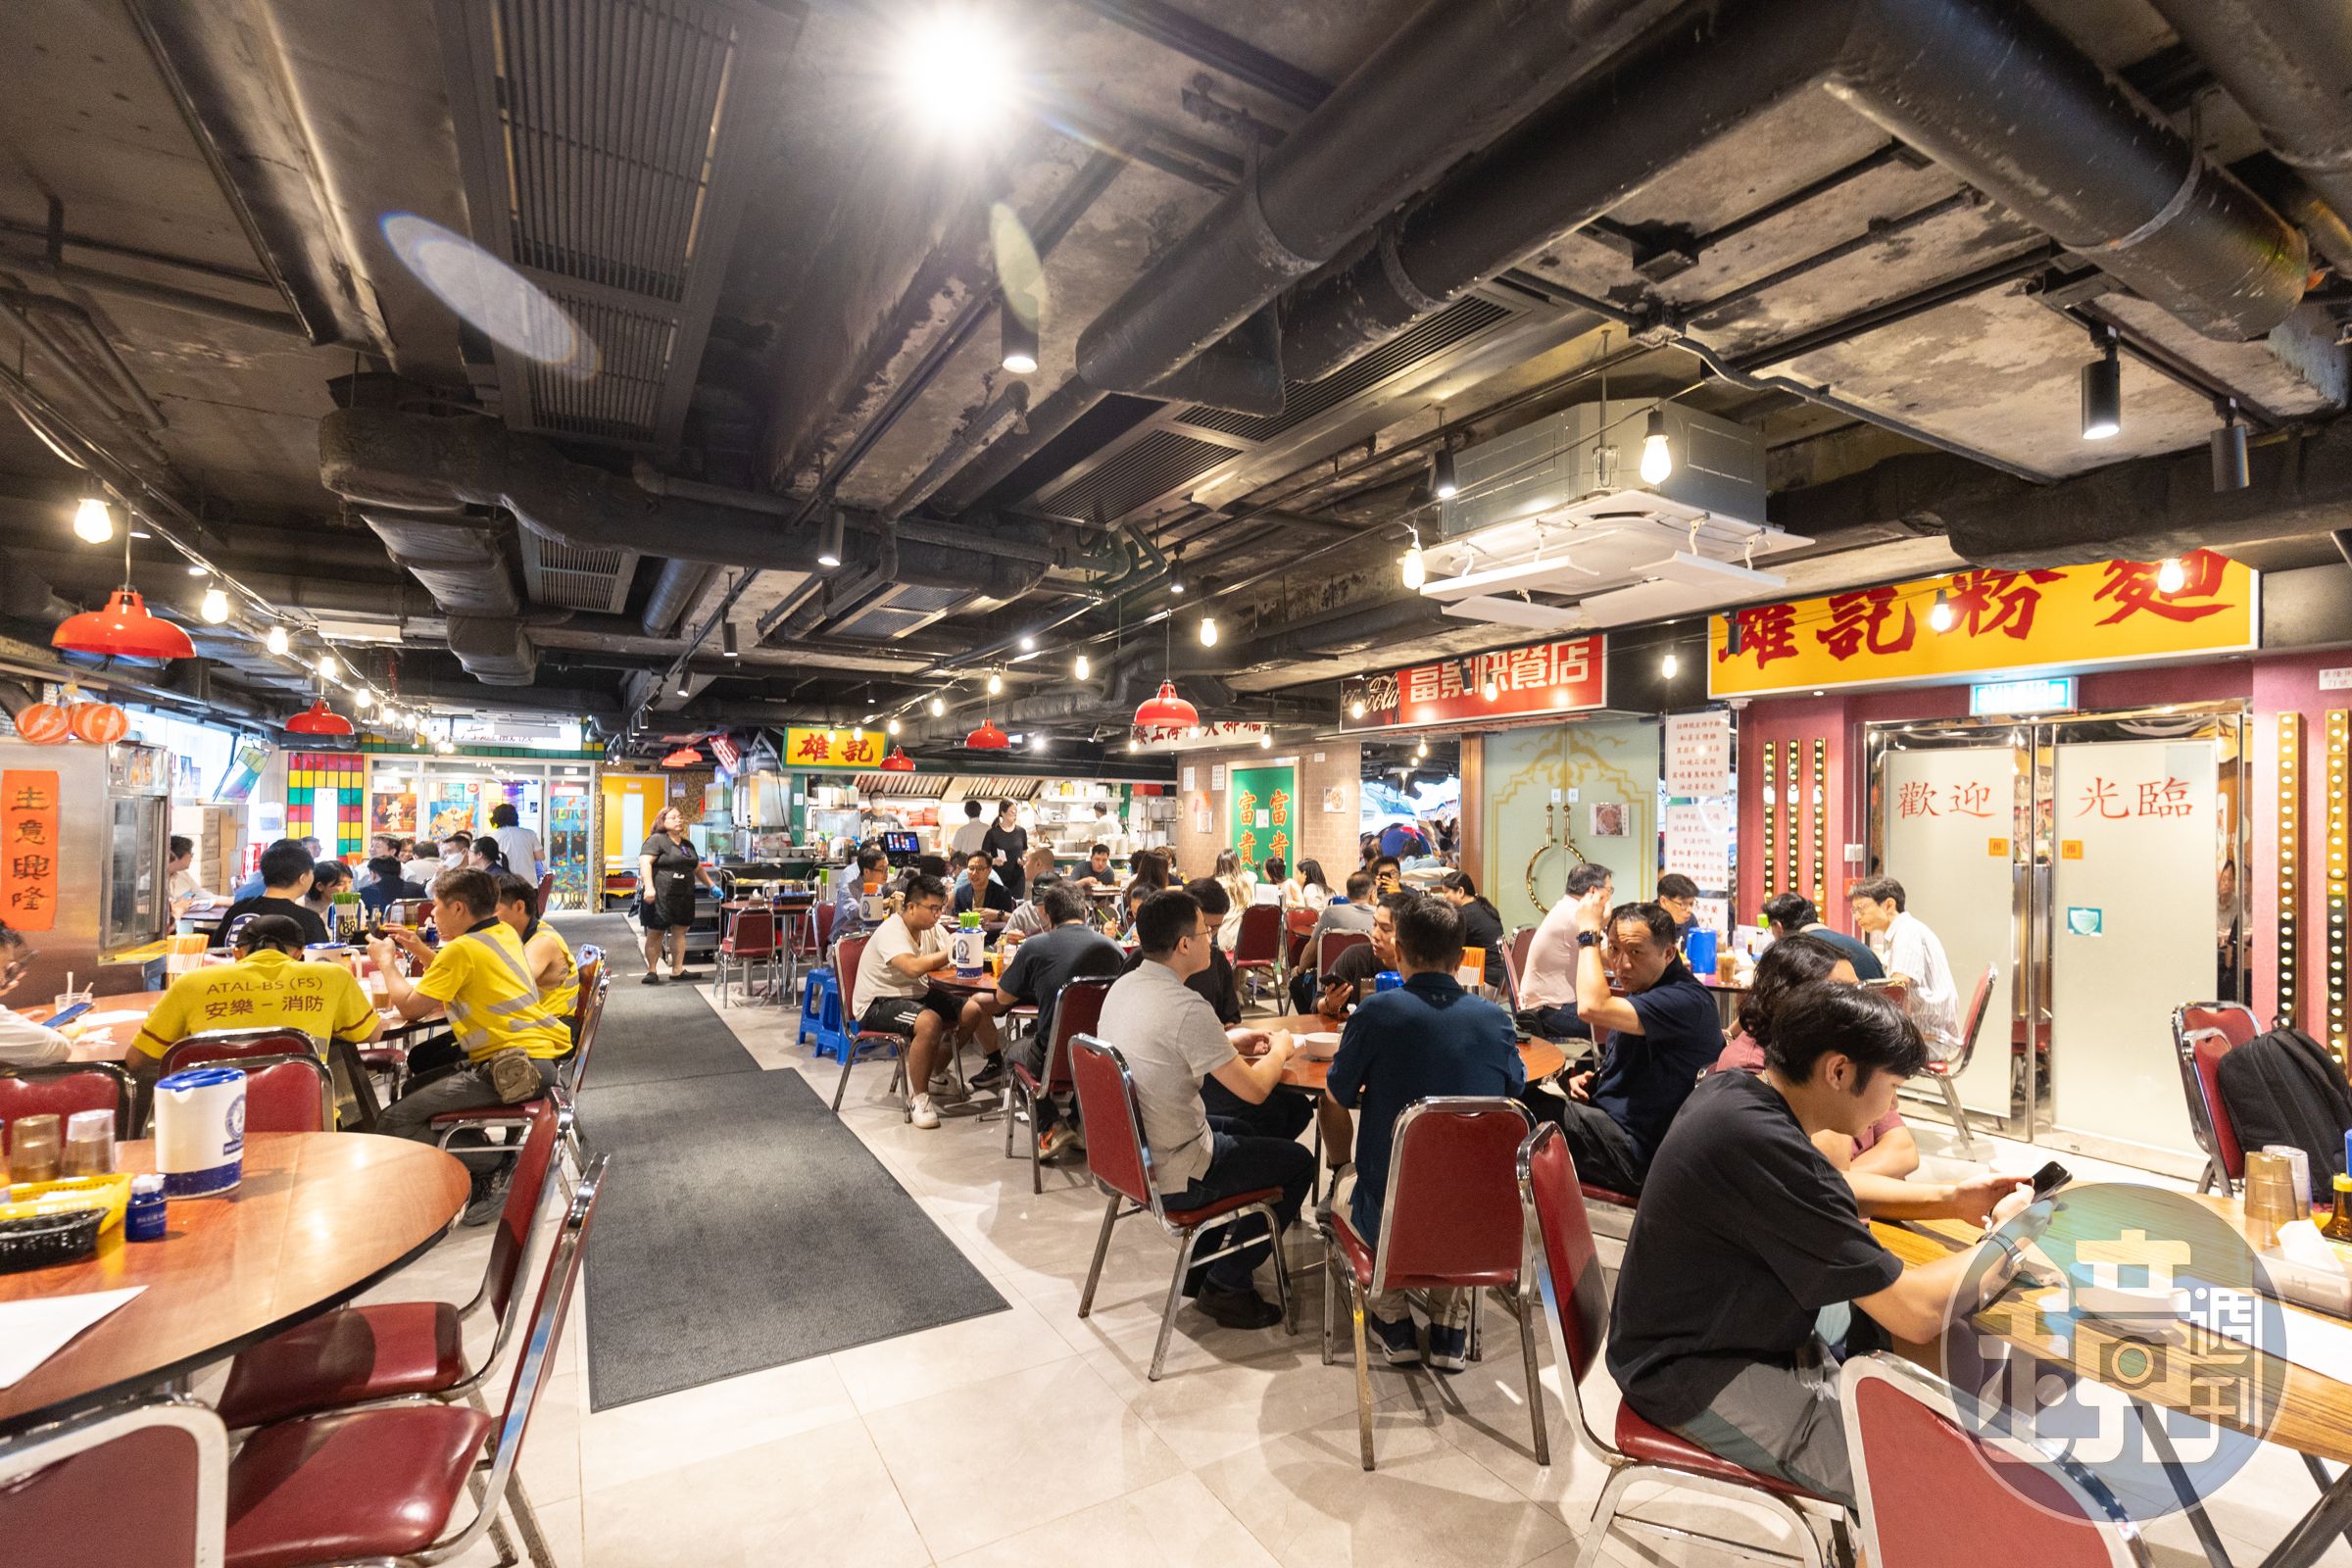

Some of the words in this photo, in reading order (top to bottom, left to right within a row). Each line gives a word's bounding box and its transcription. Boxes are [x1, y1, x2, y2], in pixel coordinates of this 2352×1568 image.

[1718, 548, 2236, 669] 雄記粉麵
[797, 732, 874, 762] 雄記
[1896, 781, 1998, 819] 歡迎
[2073, 776, 2193, 819] 光臨
[10, 786, 50, 910] 生意興隆
[1238, 790, 1257, 872] 富貴
[206, 980, 284, 995] ATAL-BS
[289, 977, 322, 991] (FS)
[205, 998, 255, 1020] 安樂
[281, 995, 324, 1012] 消防
